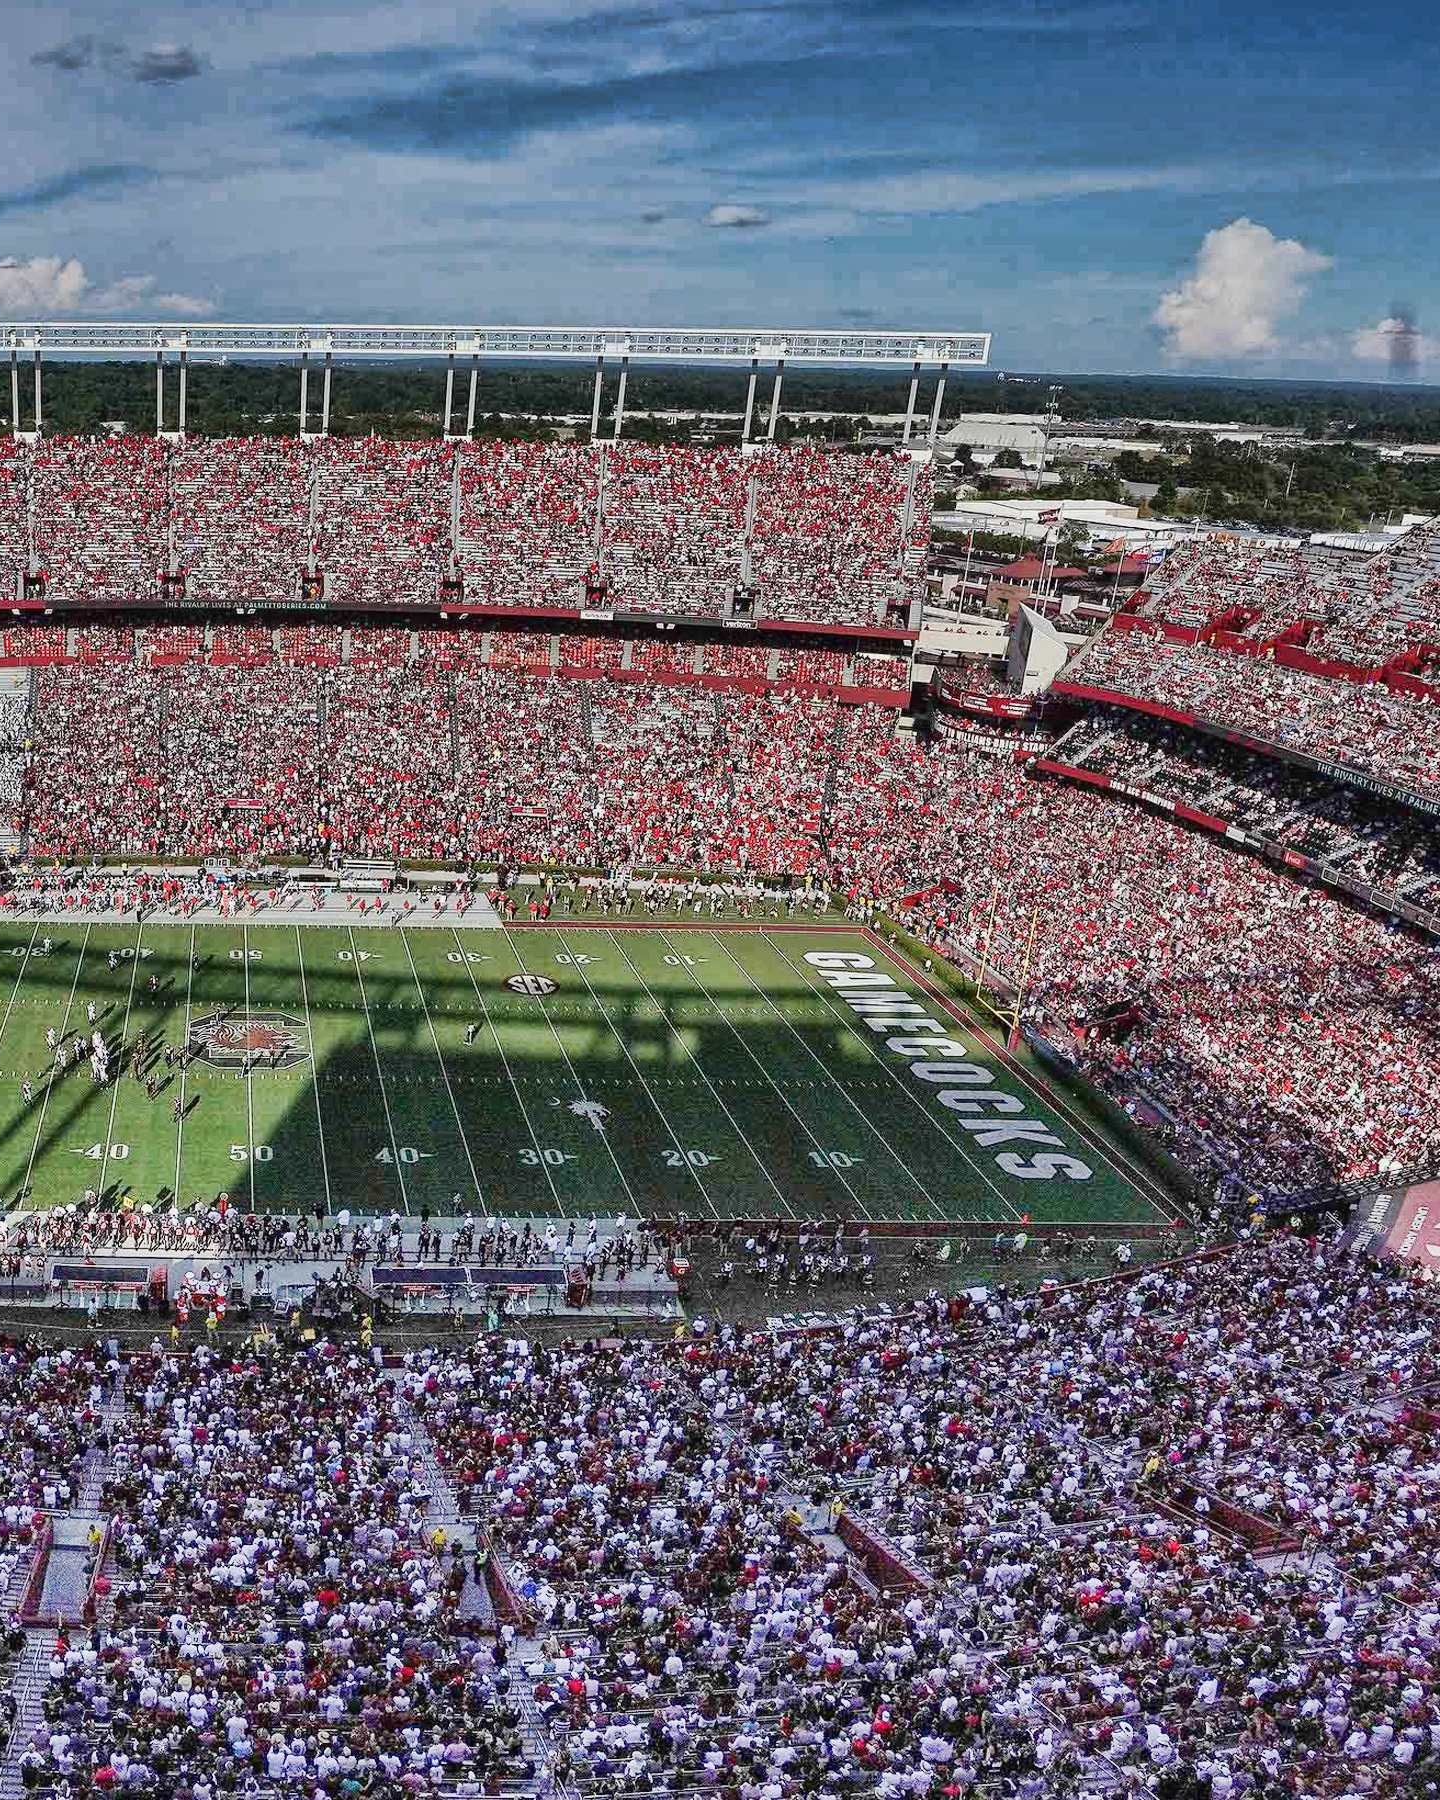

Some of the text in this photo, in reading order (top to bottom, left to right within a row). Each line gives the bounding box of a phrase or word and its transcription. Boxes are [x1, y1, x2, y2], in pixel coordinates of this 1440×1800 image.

[165, 601, 327, 609] THE RIVALRY LIVES AT PALMETTOSERIES.COM
[725, 620, 751, 629] verizon
[956, 730, 1020, 750] WILLIAMS-BRICE
[1316, 762, 1333, 775] THE
[1334, 767, 1369, 788] RIVALRY
[1369, 780, 1394, 798] LIVES
[1394, 791, 1406, 803] AT
[507, 974, 556, 995] SEC
[802, 951, 1093, 1180] GAMECOCKS
[83, 1144, 131, 1161] 40
[229, 1145, 274, 1162] 50
[374, 1147, 420, 1164] 40
[518, 1149, 566, 1166] 30
[661, 1149, 711, 1167] 20
[808, 1151, 854, 1168] 10
